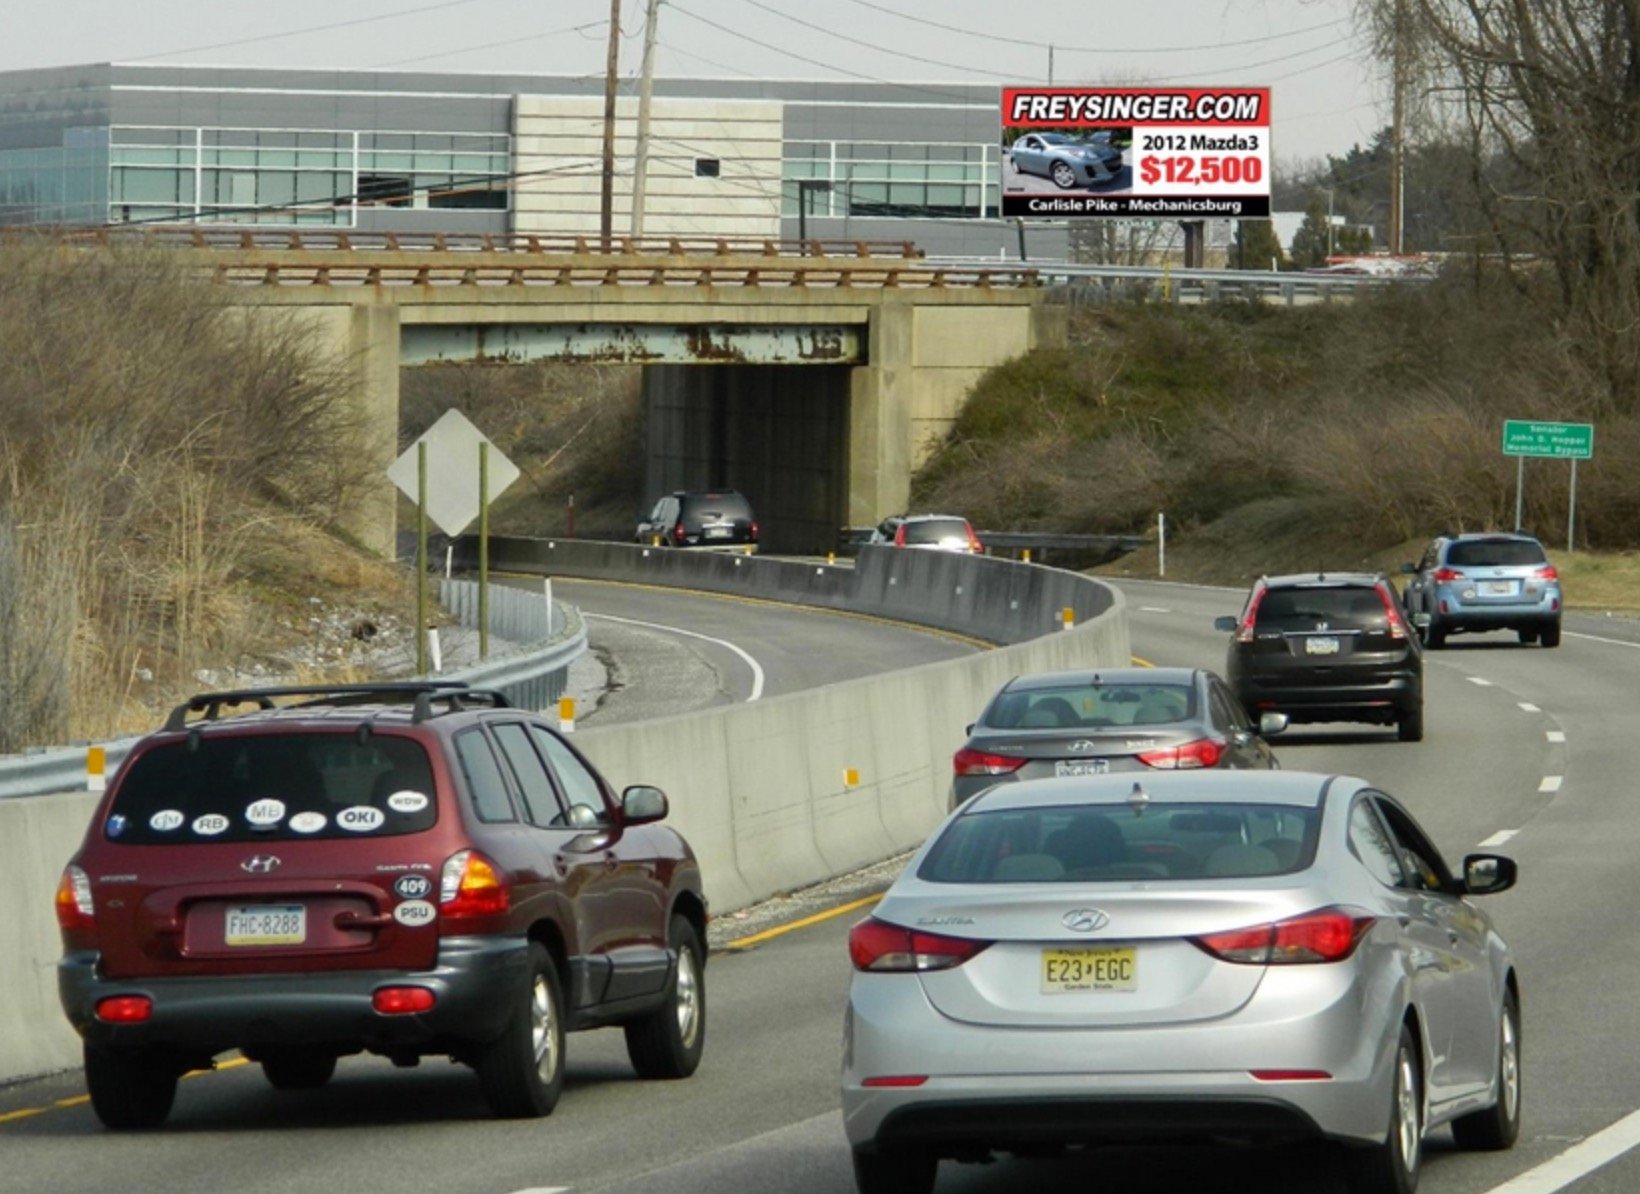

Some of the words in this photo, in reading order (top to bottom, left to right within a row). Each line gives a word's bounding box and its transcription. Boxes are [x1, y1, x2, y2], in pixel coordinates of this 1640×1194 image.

[1012, 94, 1261, 120] FREYSINGER.COM
[1143, 134, 1186, 151] 2012
[1190, 134, 1259, 151] Mazda3
[1140, 155, 1262, 185] $12,500
[1028, 198, 1083, 212] Carlisle
[1086, 198, 1118, 212] Pike
[1128, 198, 1242, 215] Mechanicsburg
[199, 817, 224, 830] RB
[344, 811, 377, 823] OKI
[400, 879, 426, 893] 409
[400, 906, 429, 918] PSU
